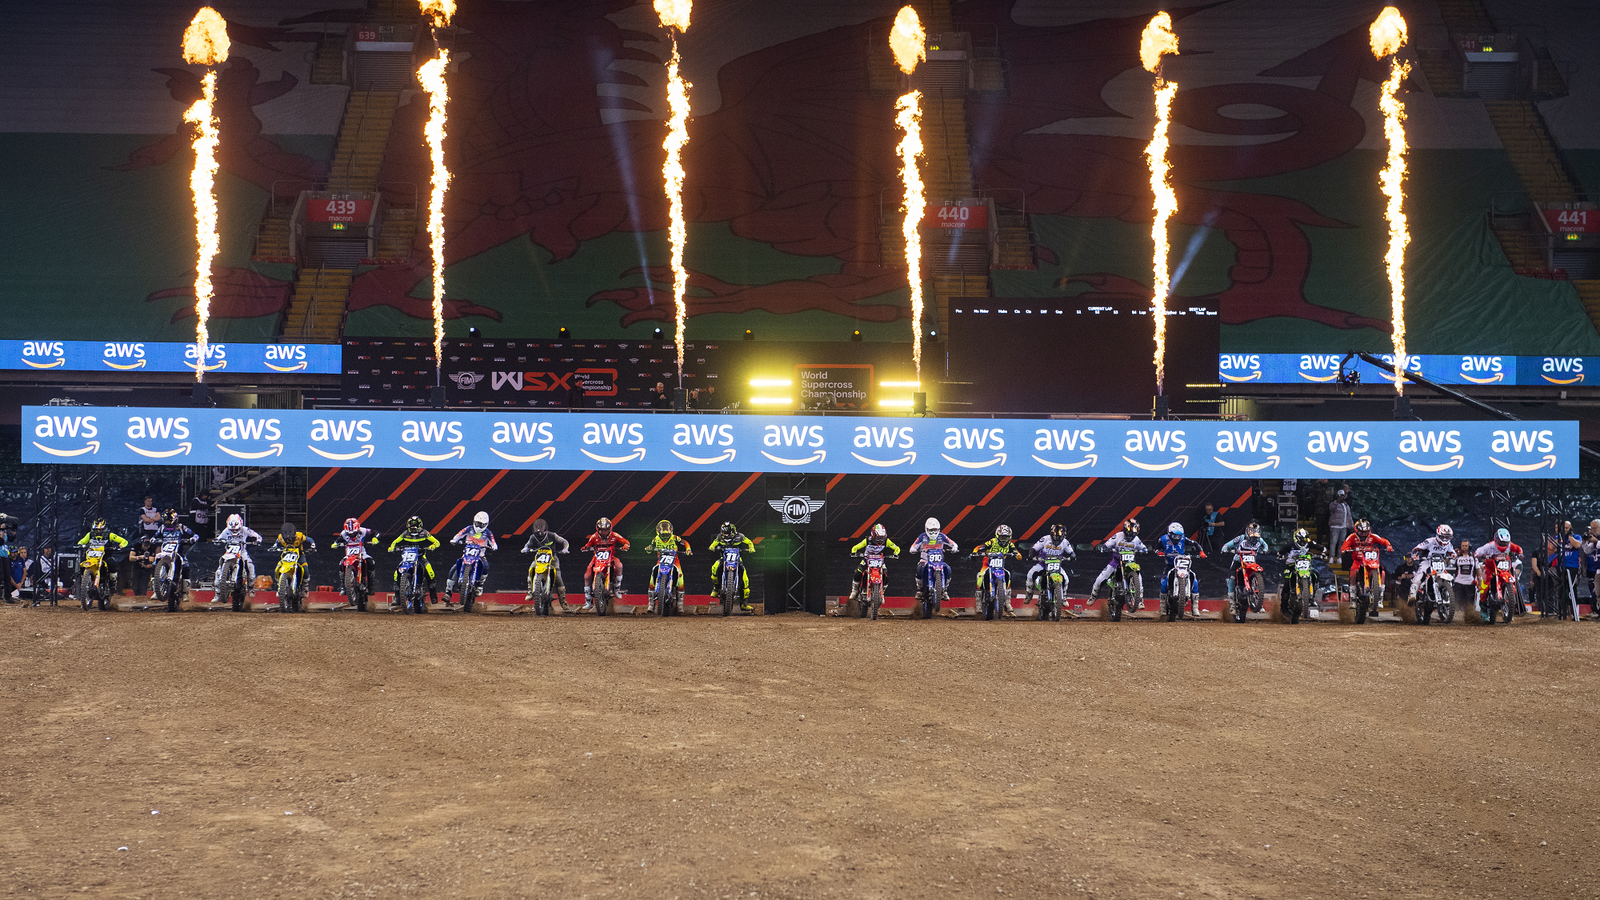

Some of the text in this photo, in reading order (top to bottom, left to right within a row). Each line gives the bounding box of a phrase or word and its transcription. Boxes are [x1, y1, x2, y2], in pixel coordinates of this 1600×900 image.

[359, 31, 376, 40] 639
[326, 200, 356, 215] 439
[938, 207, 970, 221] 440
[1557, 210, 1587, 225] 441
[23, 342, 64, 357] aws
[104, 343, 145, 358] aws
[265, 346, 306, 360] aws
[1219, 354, 1261, 370] aws
[1300, 355, 1341, 370] aws
[1461, 356, 1502, 372] aws
[1542, 357, 1583, 373] aws
[491, 371, 574, 391] WSX
[801, 371, 828, 380] World
[801, 381, 853, 391] Supercross
[36, 416, 1553, 453] aws aws aws aws aws aws aws aws aws aws aws aws aws aws aws aws aws
[788, 503, 806, 516] FIM
[536, 554, 551, 563] 41
[597, 551, 610, 560] 20
[929, 554, 942, 562] 910
[1047, 563, 1060, 571] 66
[1497, 561, 1510, 570] 48
